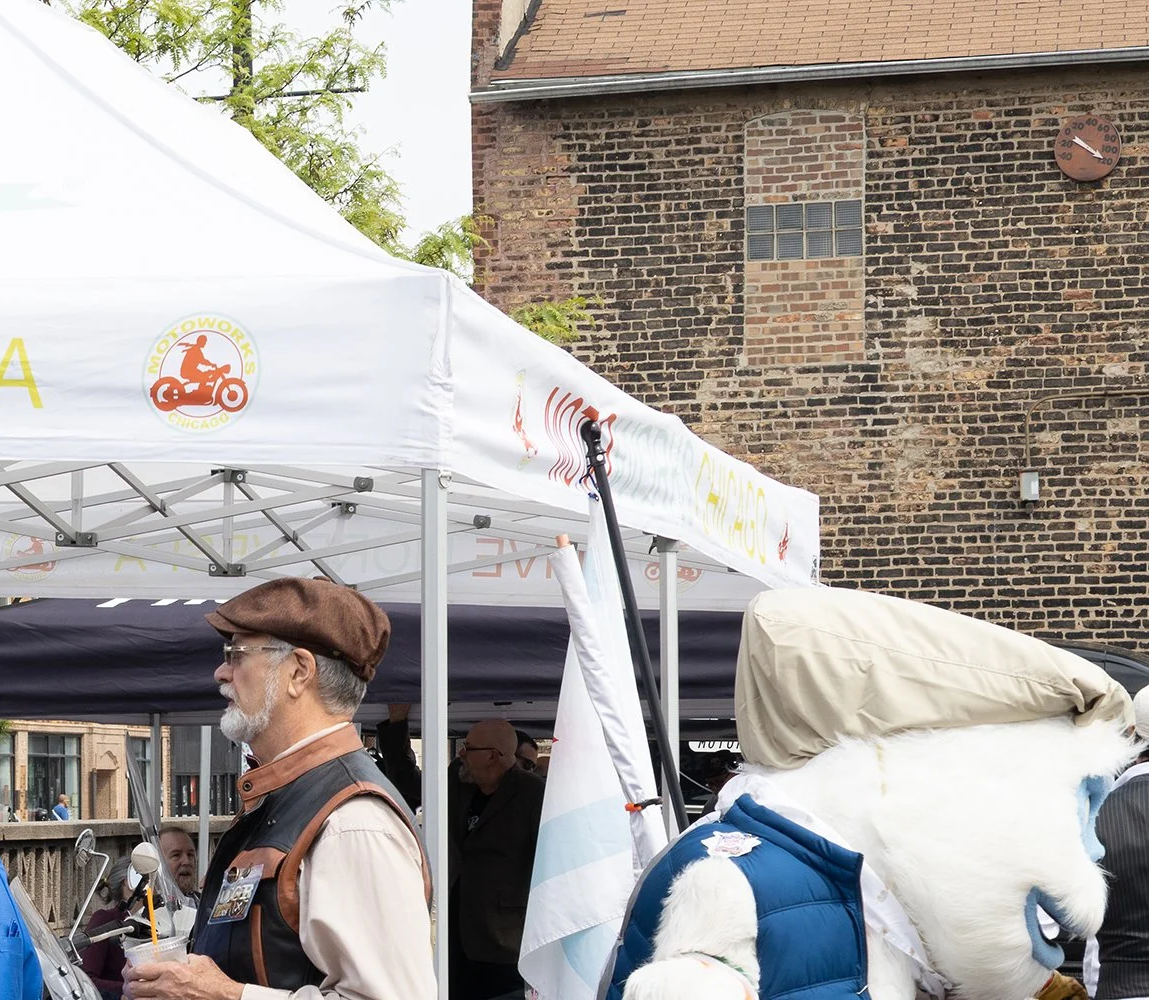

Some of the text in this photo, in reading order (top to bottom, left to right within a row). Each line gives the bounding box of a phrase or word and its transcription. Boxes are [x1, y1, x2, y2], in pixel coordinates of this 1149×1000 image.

[1072, 122, 1084, 130] 20
[147, 317, 256, 375] MOTOWORKS
[167, 412, 230, 430] CHICAGO
